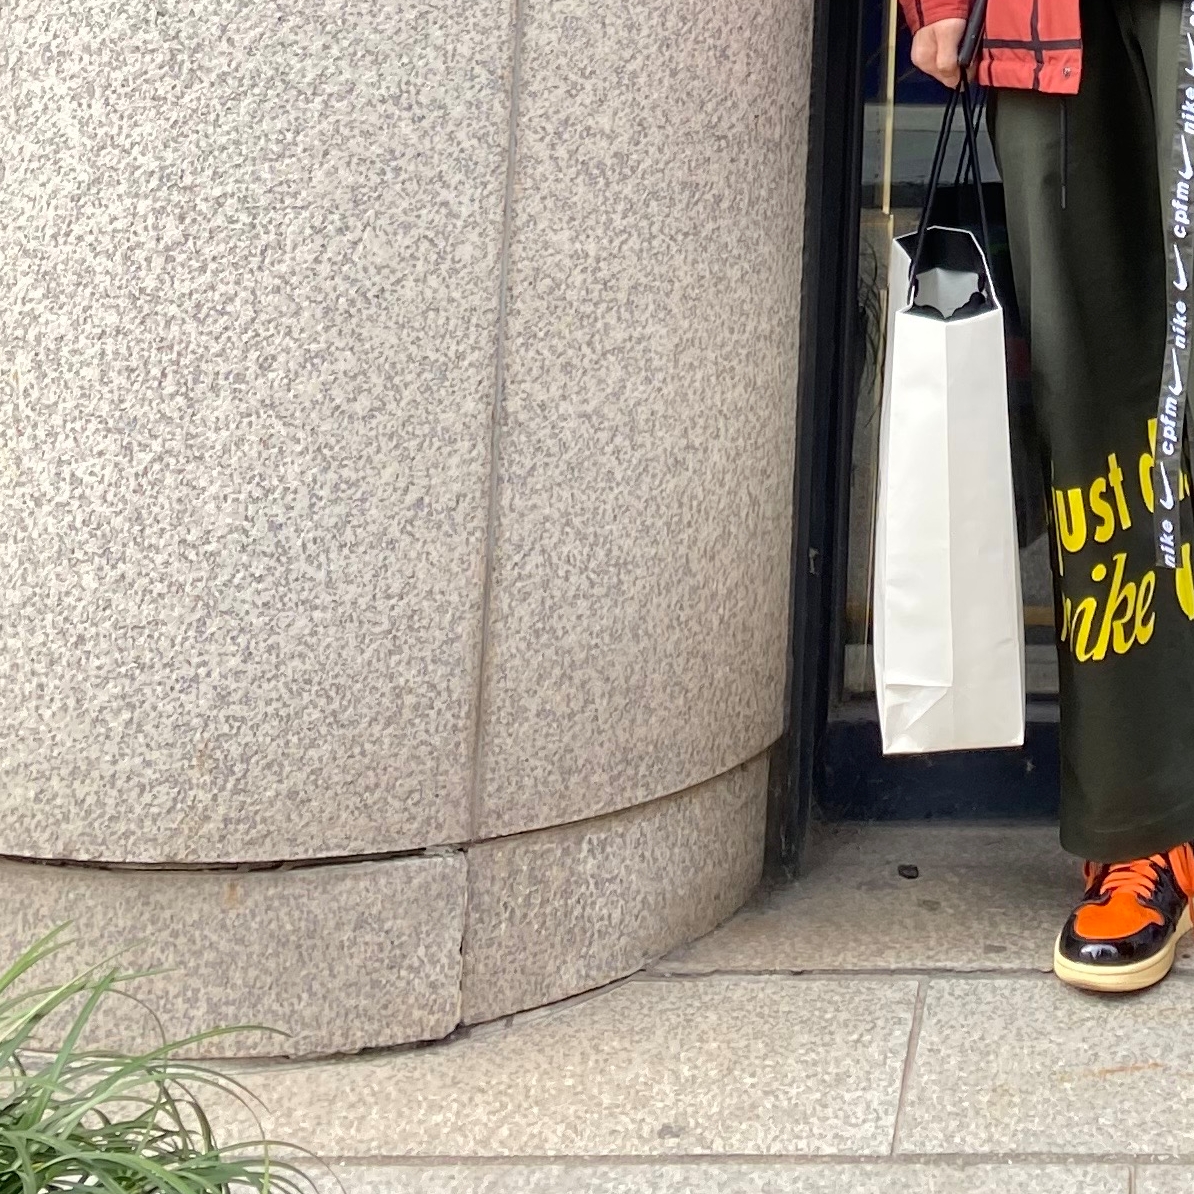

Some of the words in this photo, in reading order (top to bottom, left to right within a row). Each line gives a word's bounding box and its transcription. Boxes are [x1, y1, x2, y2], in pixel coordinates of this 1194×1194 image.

[1172, 182, 1190, 239] cpfm
[1172, 300, 1187, 349] nike
[1159, 397, 1178, 456] cpfm
[1052, 453, 1132, 576] ust
[1159, 519, 1176, 568] nike
